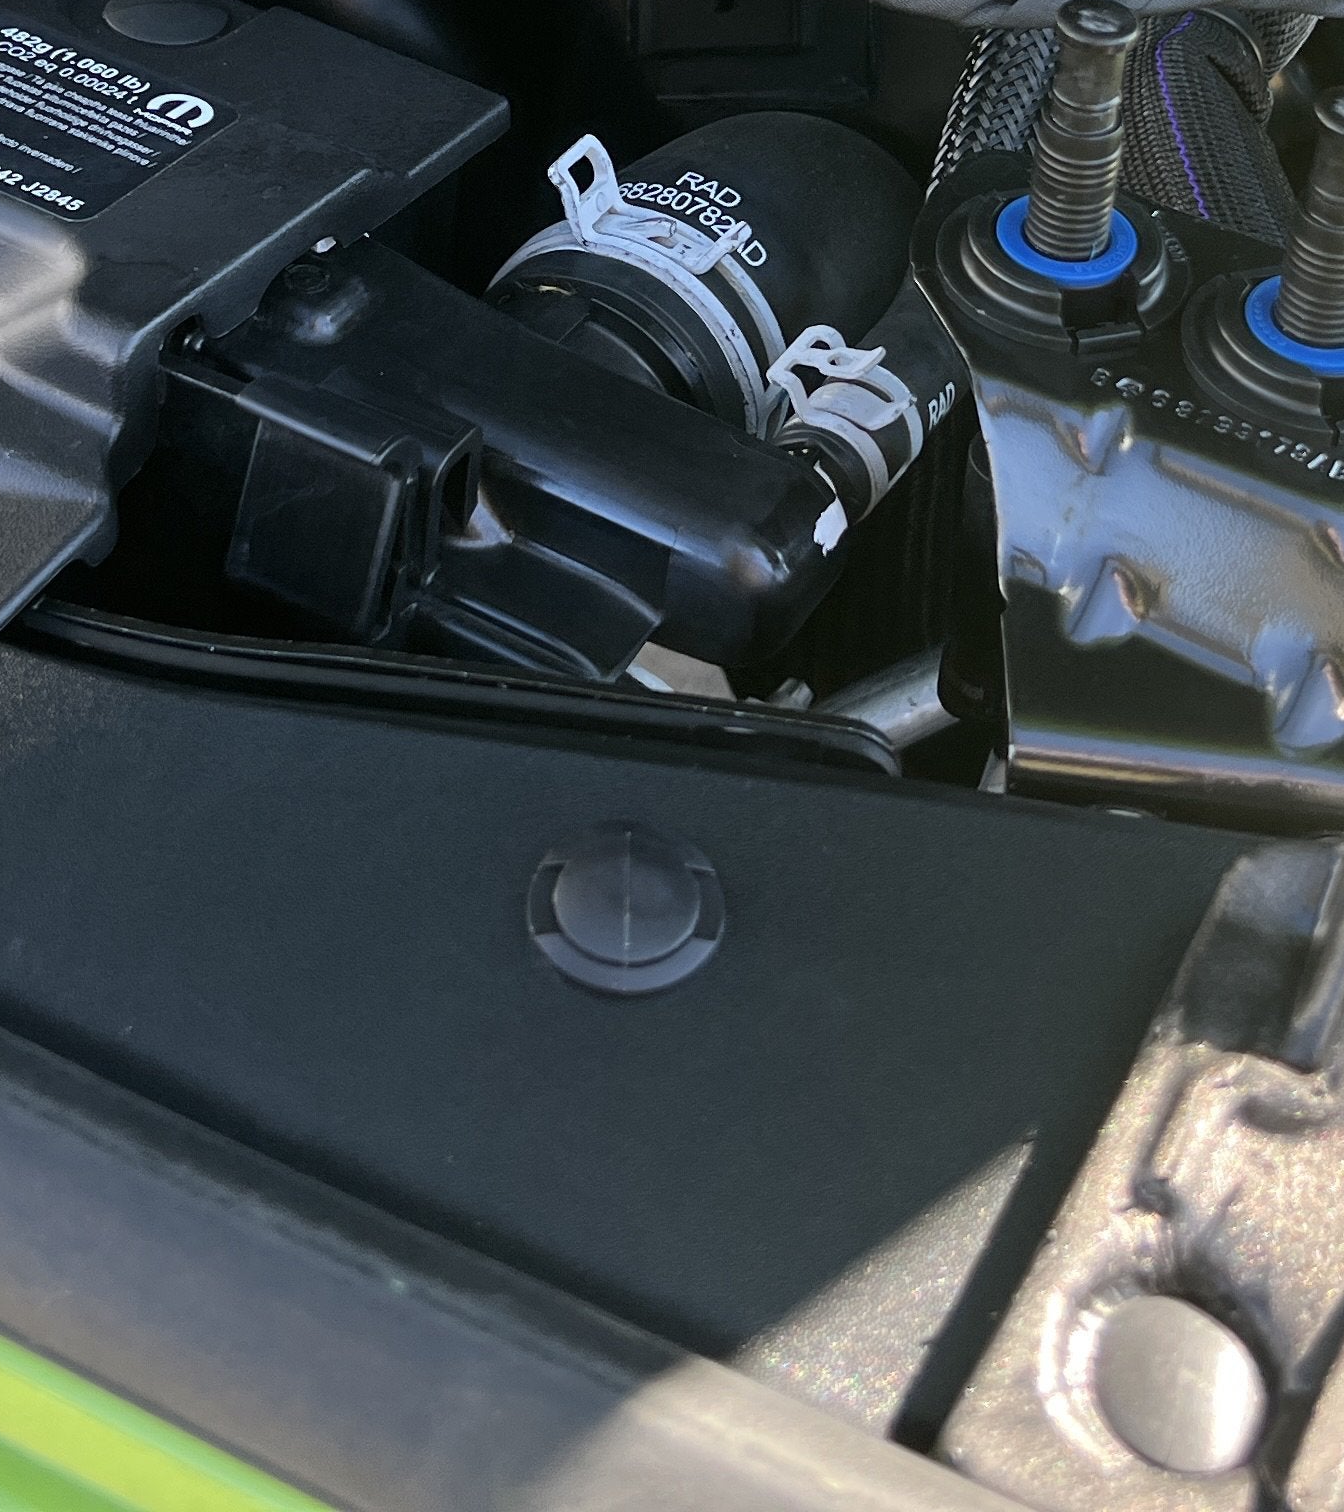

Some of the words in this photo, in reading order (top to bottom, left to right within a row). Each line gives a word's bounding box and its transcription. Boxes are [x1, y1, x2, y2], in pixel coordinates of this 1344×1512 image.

[0, 27, 53, 54] 482g
[49, 47, 119, 78] (1.060
[117, 74, 150, 93] lb)
[33, 58, 58, 73] eq
[58, 67, 128, 99] 0.00024
[20, 181, 84, 210] J2845
[676, 171, 742, 208] RAD
[619, 182, 768, 267] 68280782D
[927, 381, 956, 431] RAD
